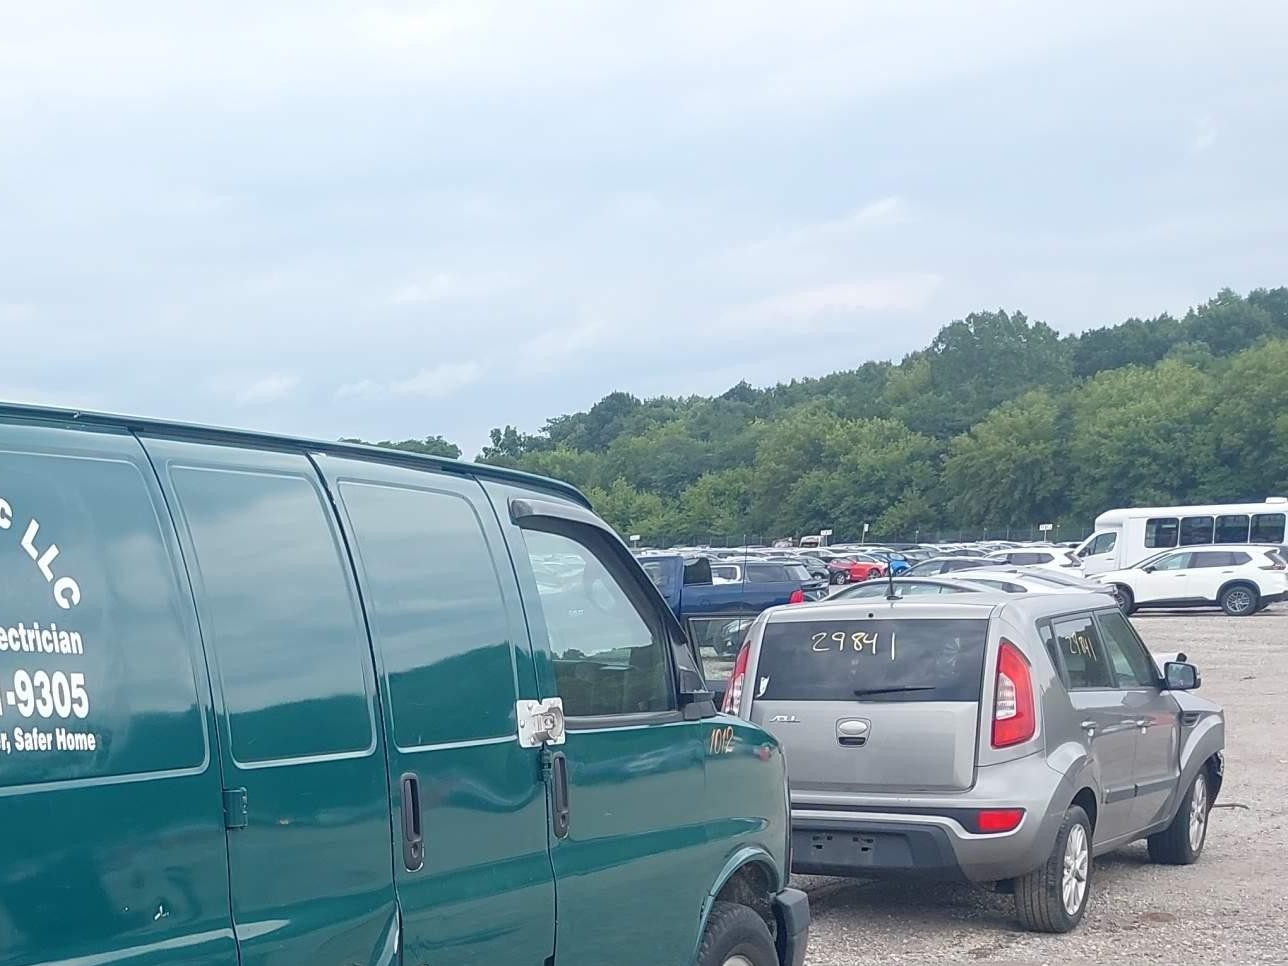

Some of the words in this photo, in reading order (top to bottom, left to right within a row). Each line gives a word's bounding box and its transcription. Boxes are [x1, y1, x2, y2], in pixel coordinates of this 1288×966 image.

[21, 518, 81, 609] LLC
[14, 727, 53, 751] Safer
[55, 728, 96, 751] Home
